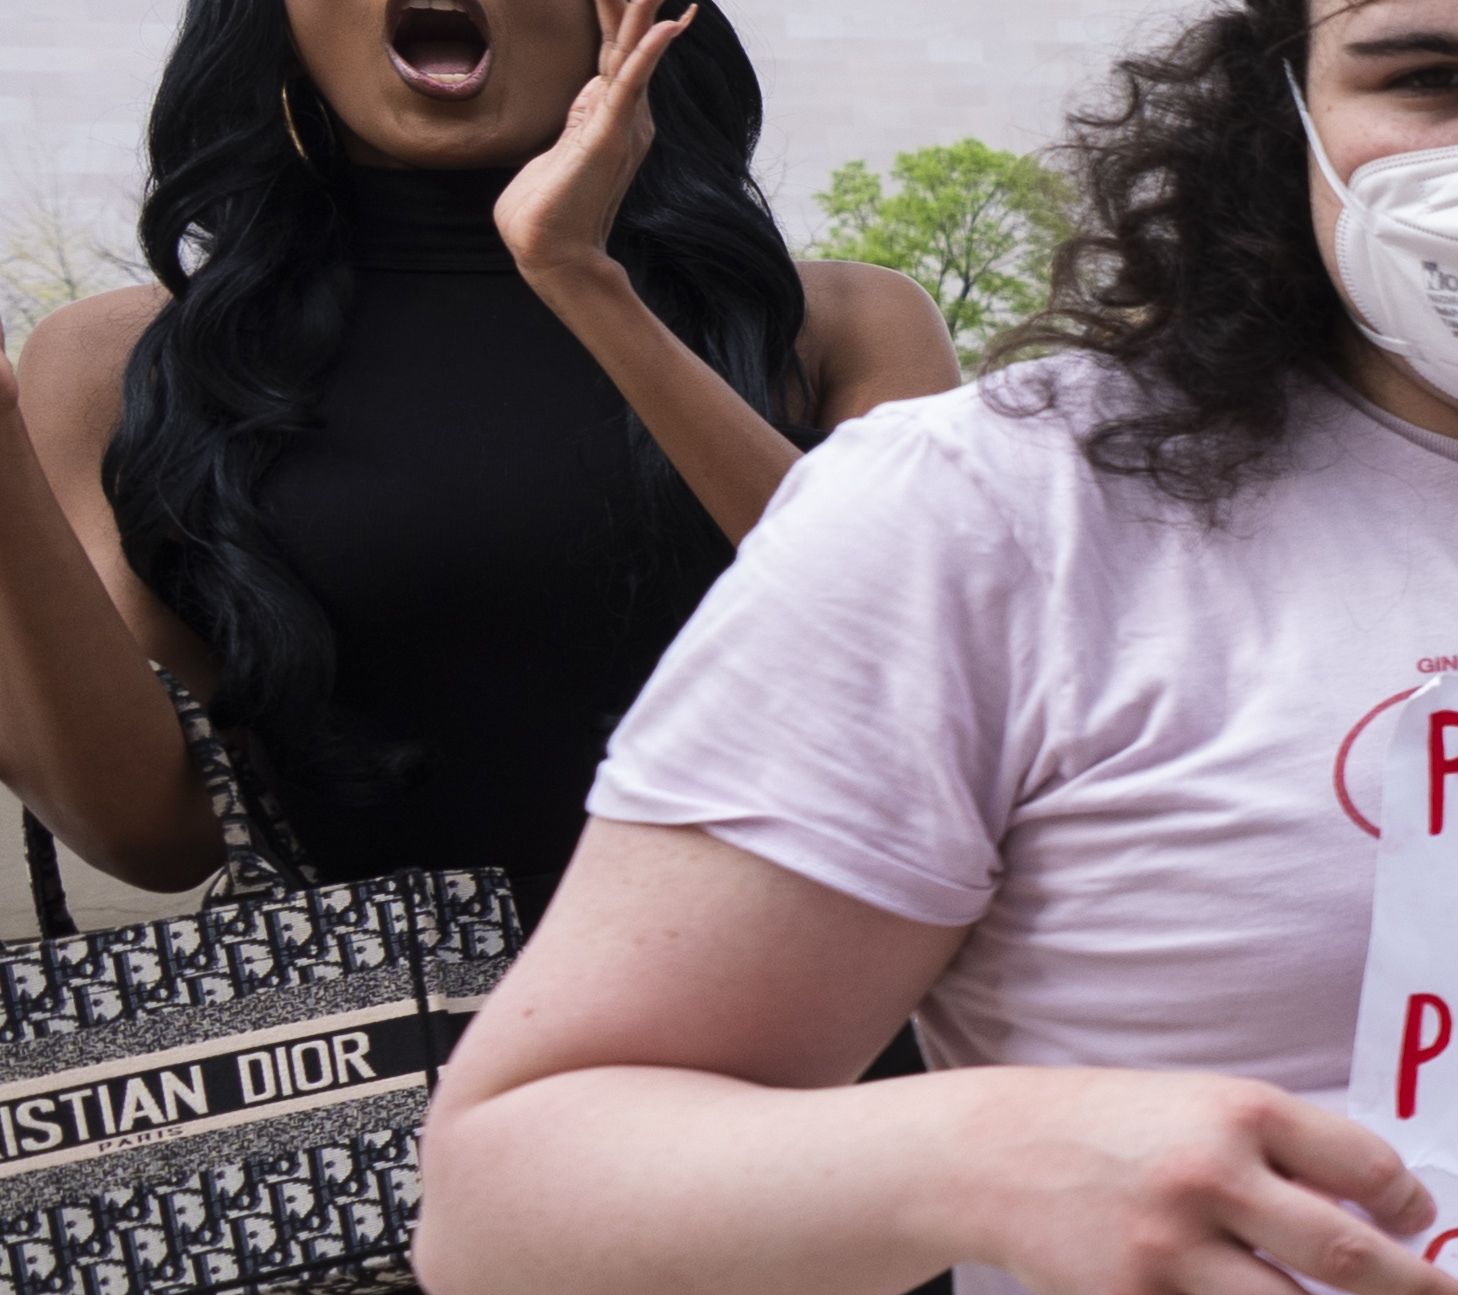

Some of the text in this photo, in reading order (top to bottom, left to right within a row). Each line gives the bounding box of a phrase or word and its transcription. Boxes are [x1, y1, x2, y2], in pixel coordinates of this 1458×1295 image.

[0, 1030, 378, 1156] ISTIAN DIOR
[98, 1125, 183, 1153] PARIS
